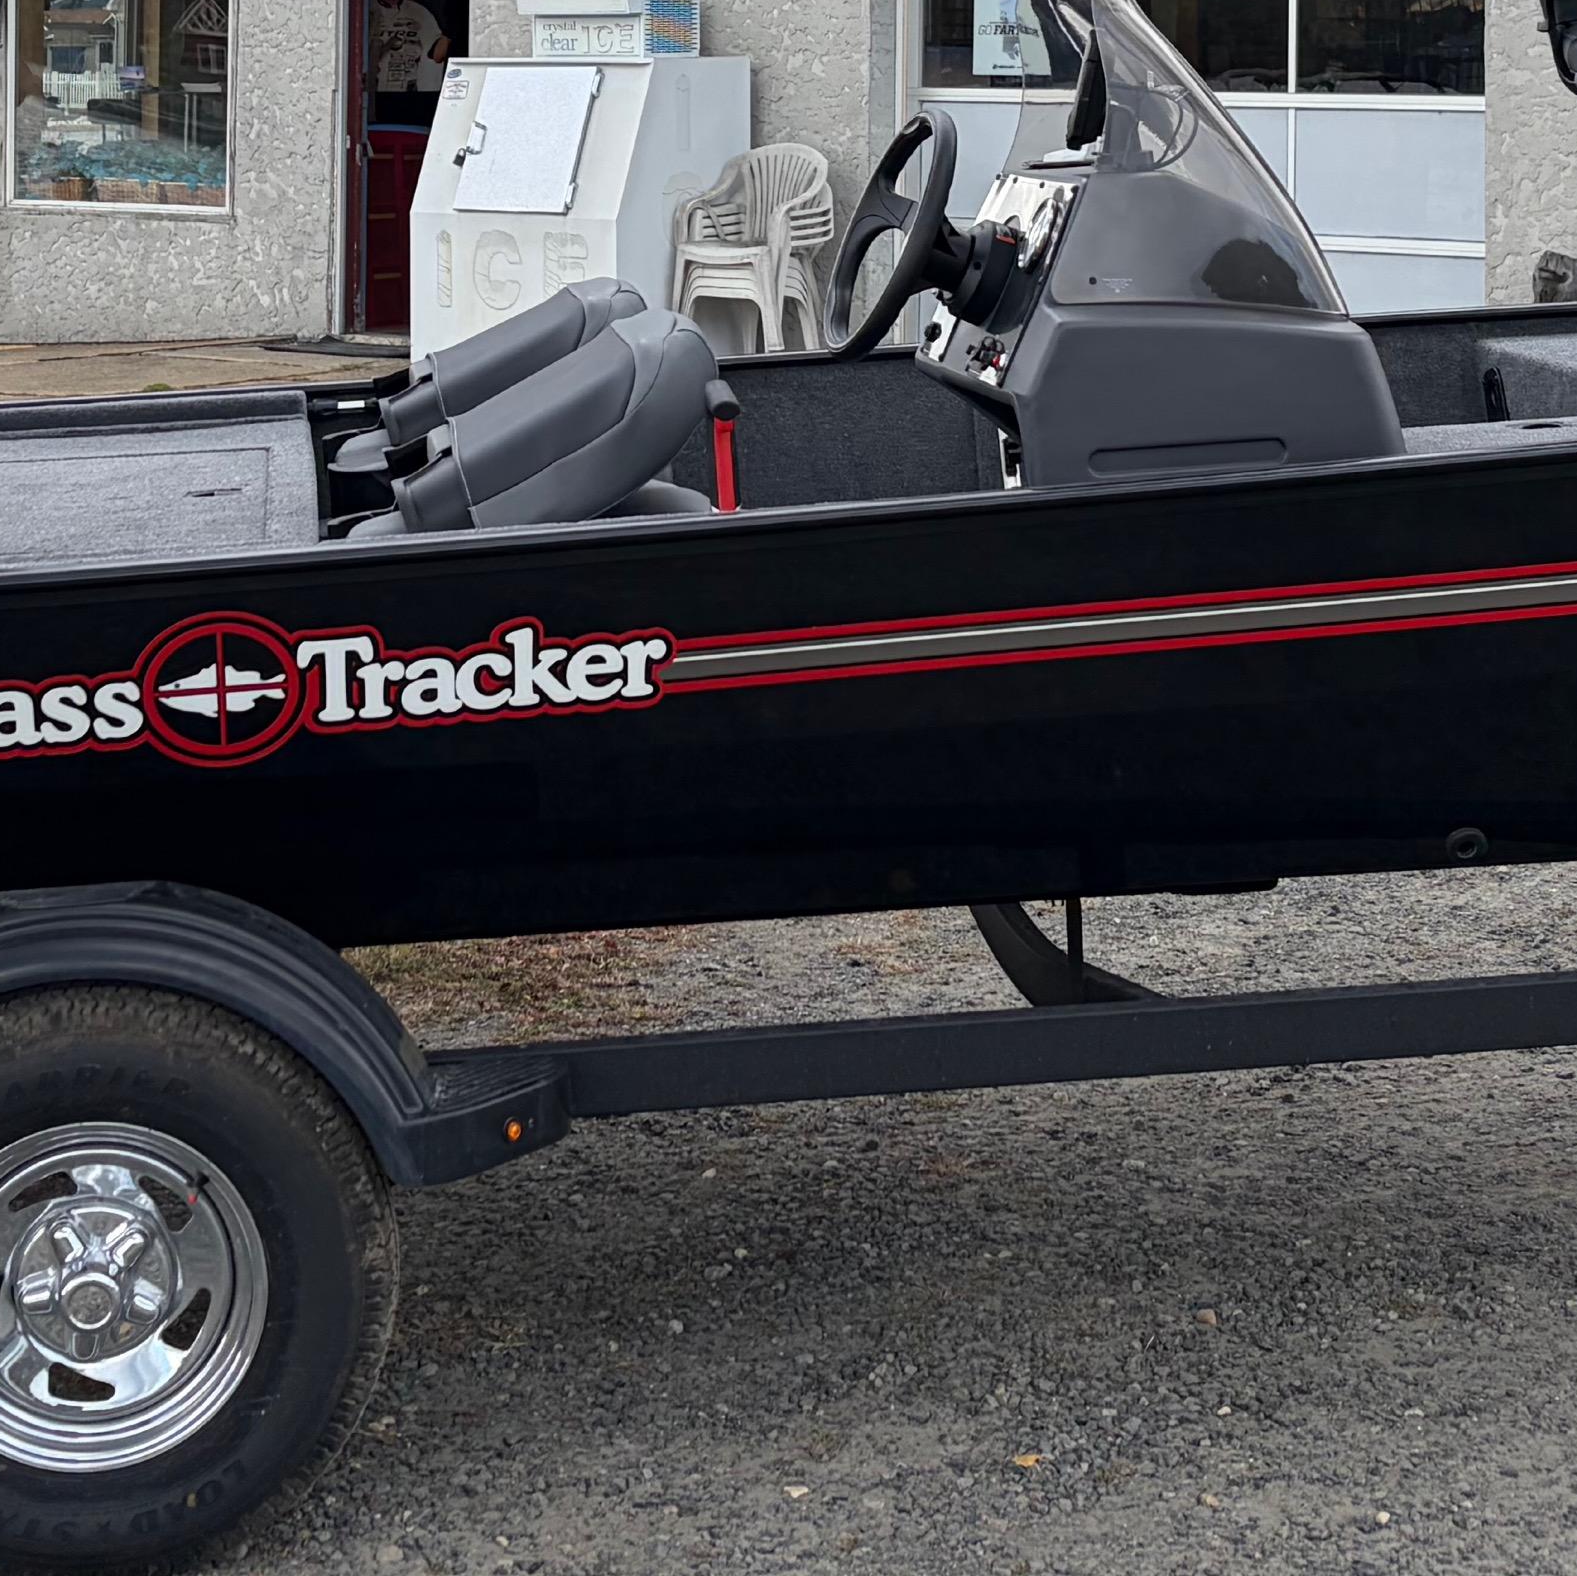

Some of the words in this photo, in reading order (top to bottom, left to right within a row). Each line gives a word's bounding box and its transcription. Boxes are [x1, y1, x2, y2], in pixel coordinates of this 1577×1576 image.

[540, 33, 577, 51] clear
[542, 21, 576, 31] crystal
[581, 23, 634, 54] ICE
[978, 24, 992, 36] GO
[436, 229, 589, 311] ICE
[297, 627, 667, 723] Tracker
